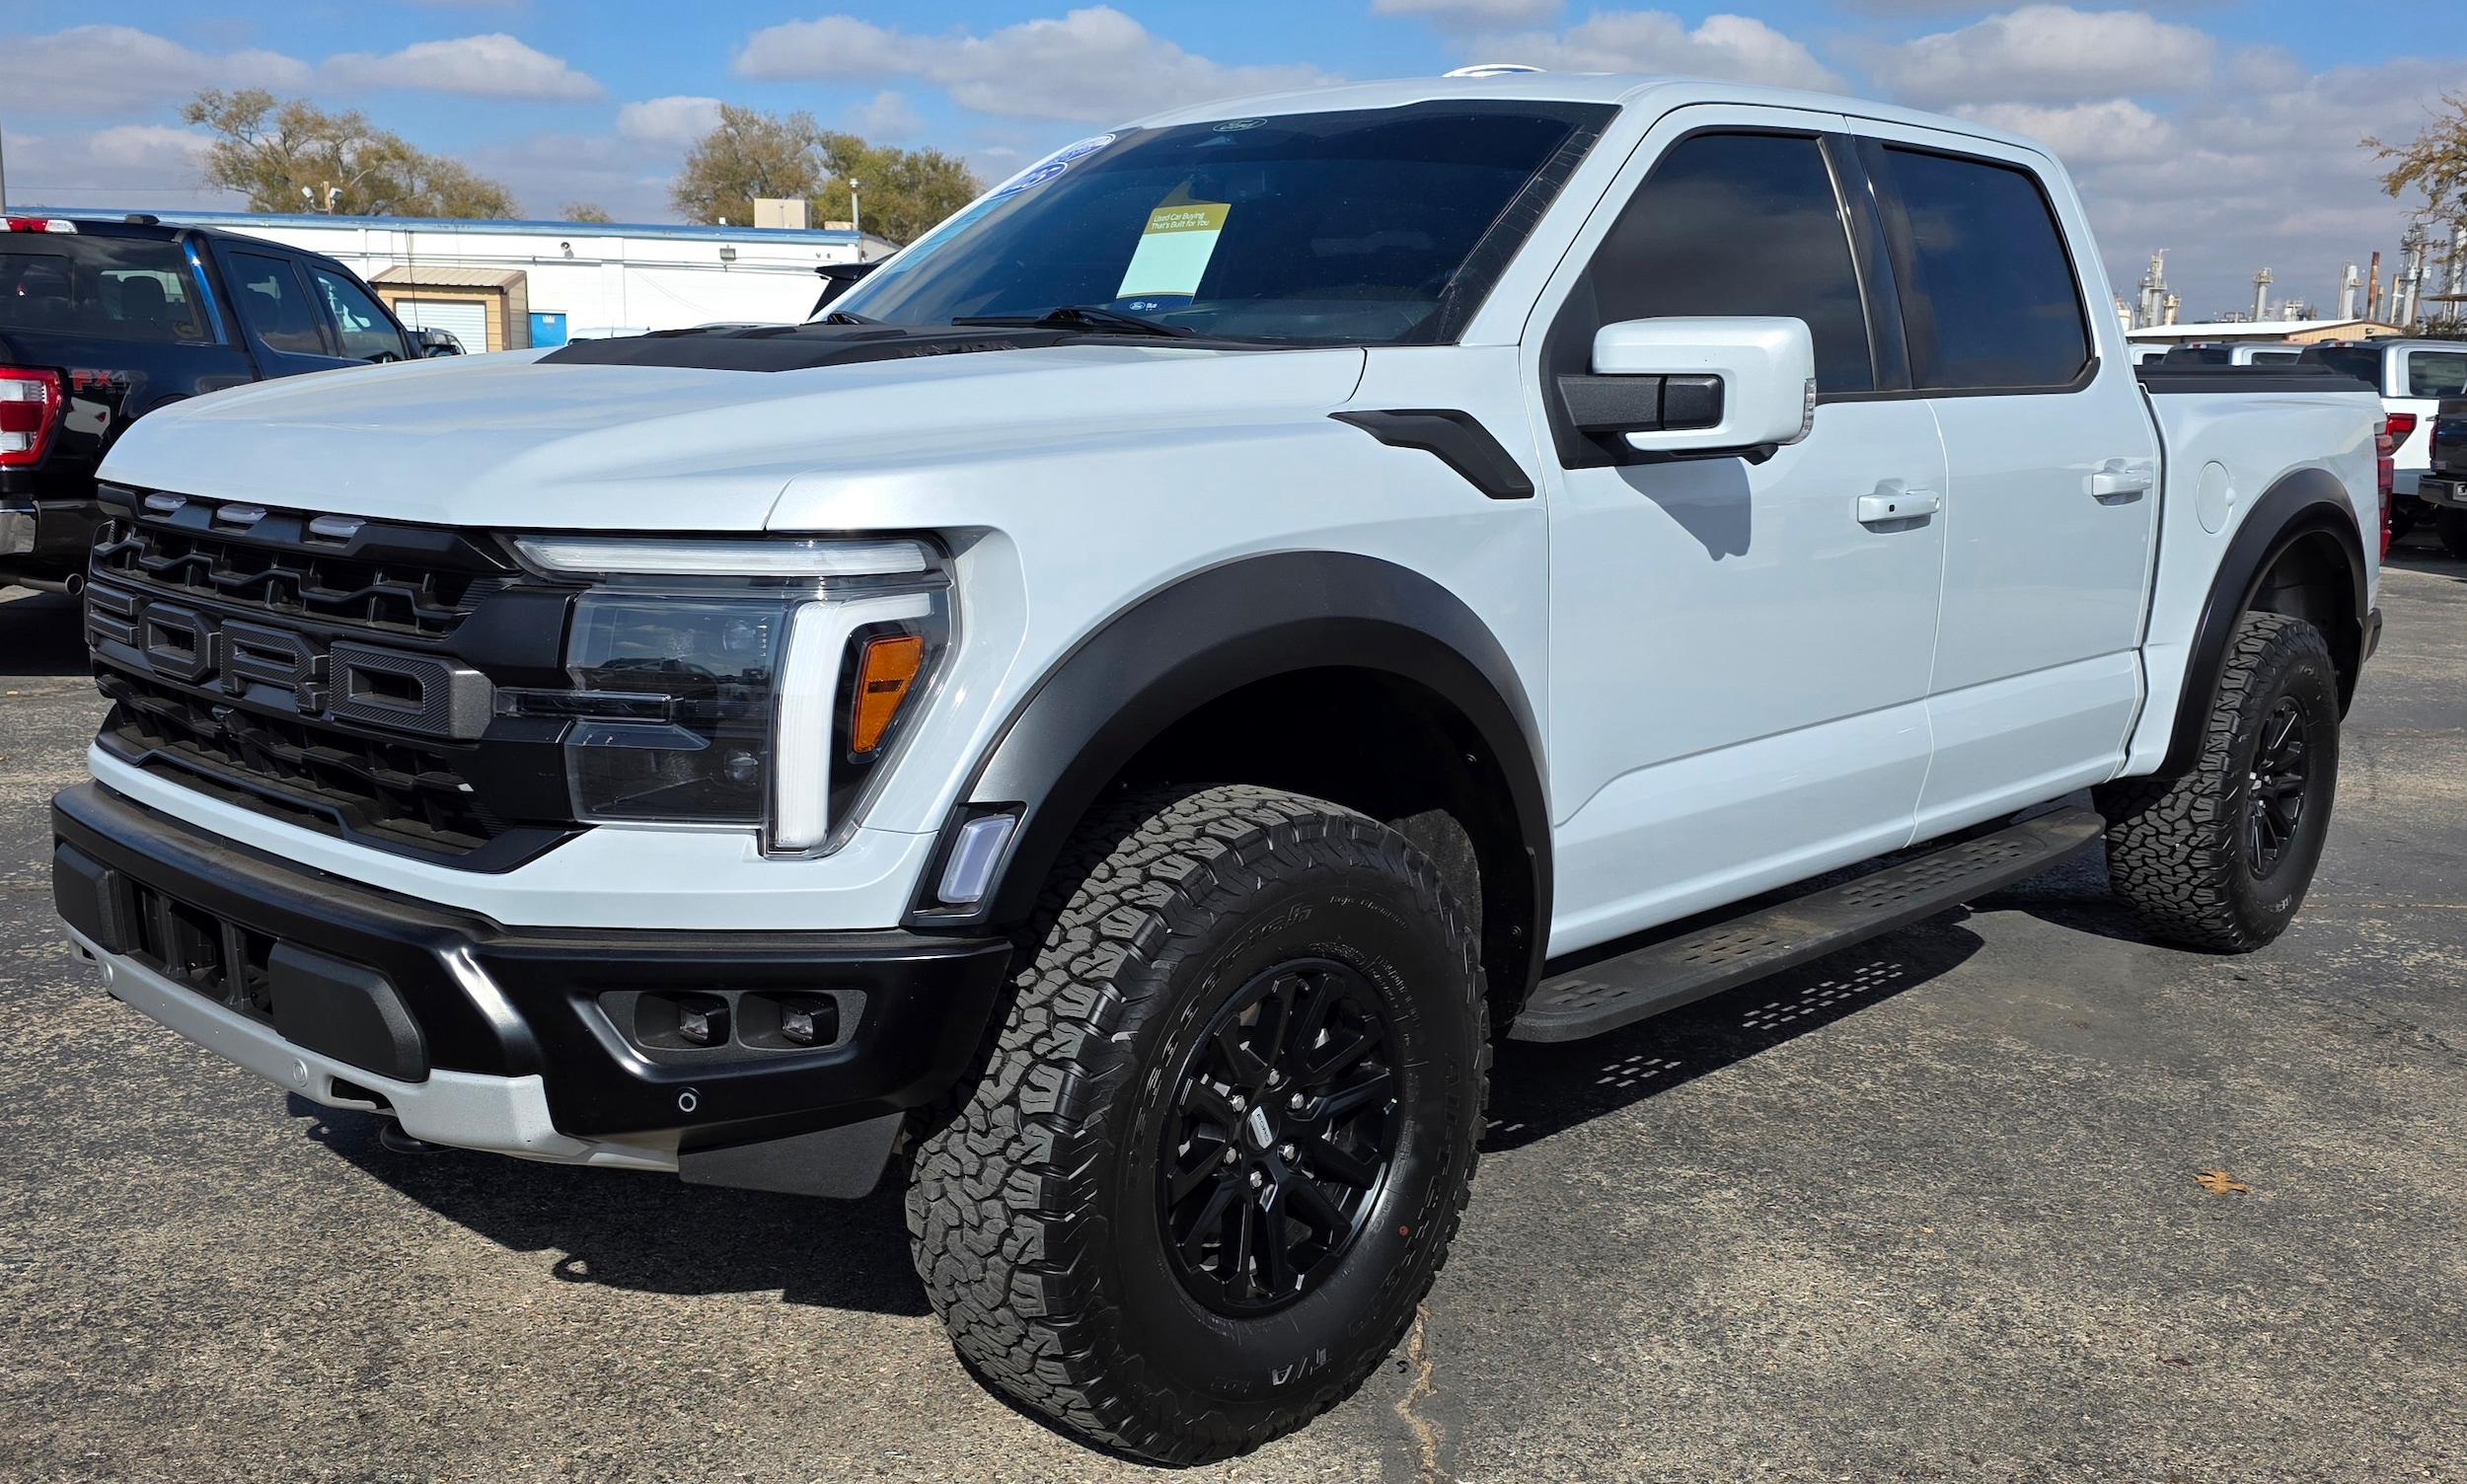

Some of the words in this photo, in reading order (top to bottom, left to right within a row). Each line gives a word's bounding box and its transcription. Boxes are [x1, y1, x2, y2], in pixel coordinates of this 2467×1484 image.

[1182, 212, 1205, 222] Buying
[73, 369, 129, 393] FX4
[85, 580, 490, 742] FORD
[1256, 1113, 1270, 1142] FORD
